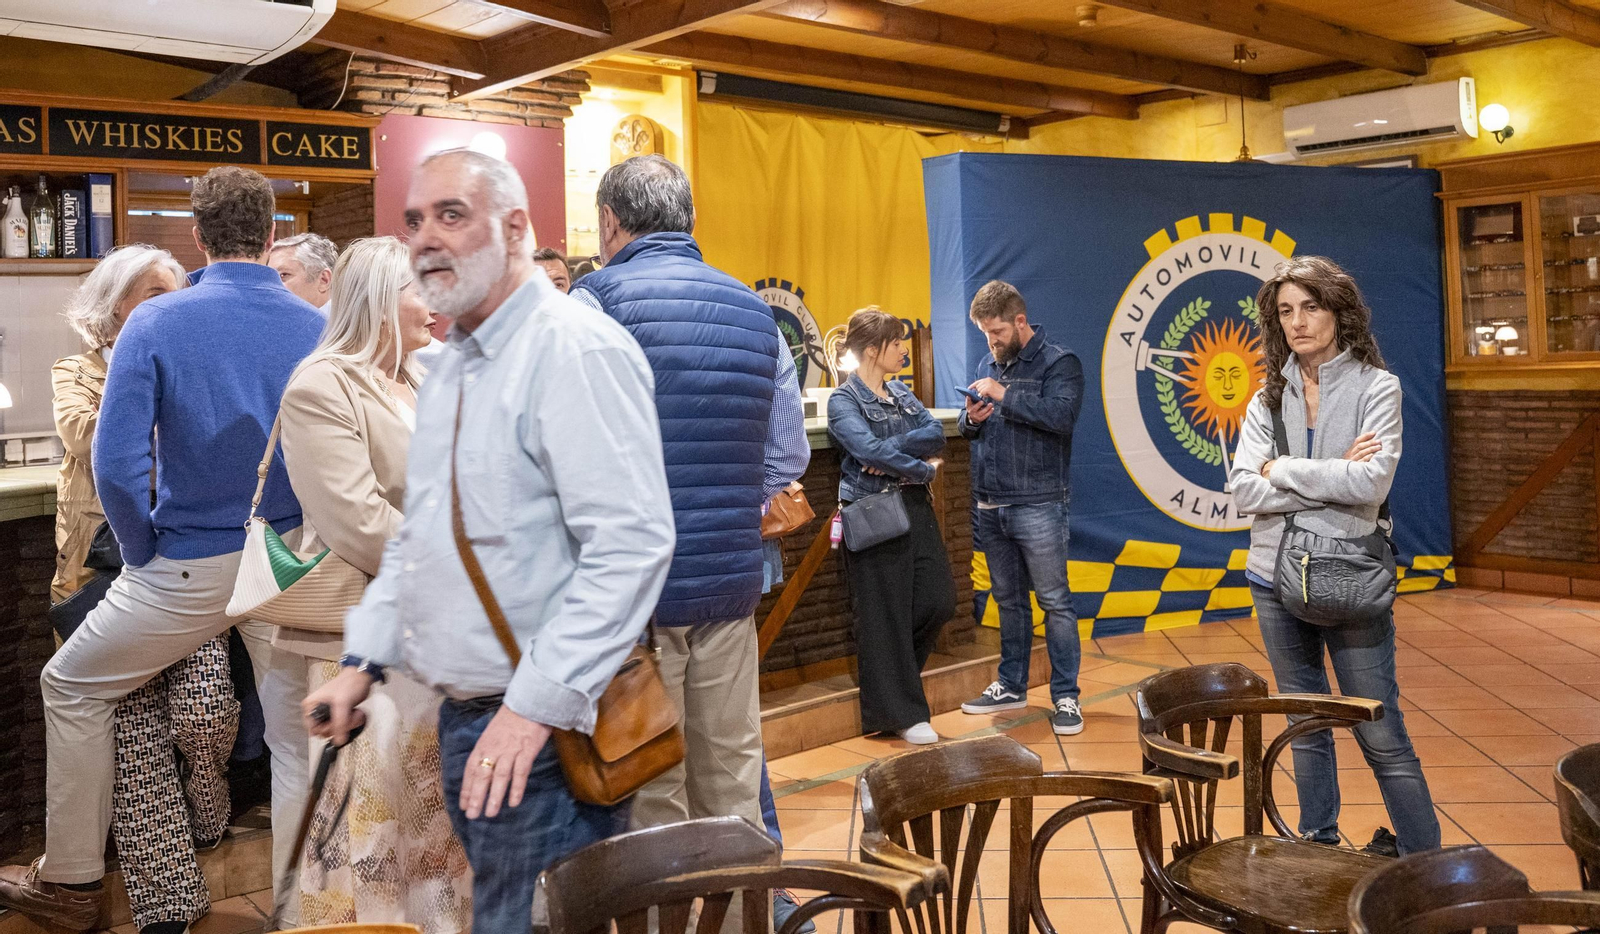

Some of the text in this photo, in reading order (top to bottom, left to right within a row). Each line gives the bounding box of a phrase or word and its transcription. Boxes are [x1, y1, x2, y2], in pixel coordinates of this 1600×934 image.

[65, 119, 243, 152] WHISKIES
[271, 131, 360, 159] CAKE
[64, 193, 78, 255] JACK DANIEL'S
[1119, 244, 1260, 347] AUTOMOVIL
